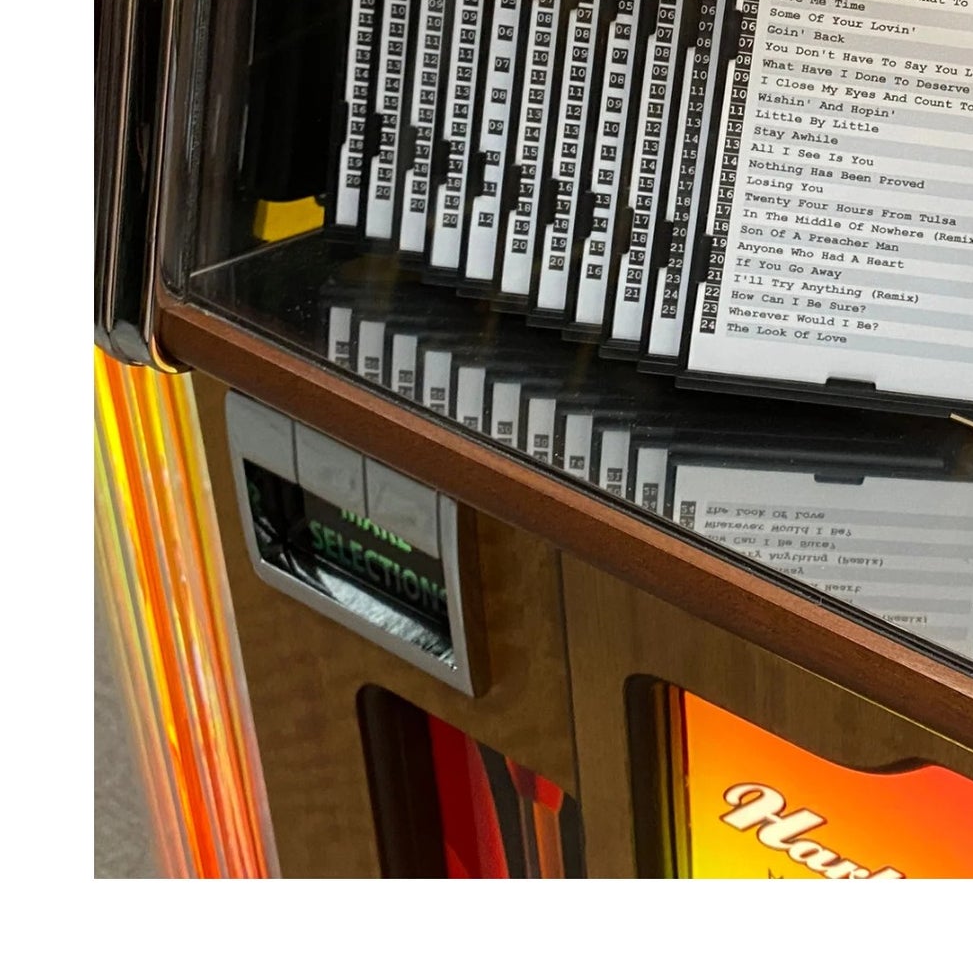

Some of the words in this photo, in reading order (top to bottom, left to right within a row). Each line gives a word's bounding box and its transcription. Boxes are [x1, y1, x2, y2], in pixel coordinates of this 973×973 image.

[767, 24, 804, 37] Goin'
[813, 31, 845, 44] Back
[762, 58, 794, 71] What
[801, 64, 833, 76] Have
[840, 69, 848, 78] I
[854, 71, 887, 83] Done
[894, 76, 910, 86] To
[916, 79, 970, 94] Deserve
[758, 92, 811, 107] Wishin'
[819, 101, 844, 112] And
[850, 105, 895, 118] Hopin'
[753, 126, 786, 140] Stay
[791, 131, 838, 145] Awhile
[748, 159, 804, 176] Nothing
[810, 167, 833, 178] Has
[840, 171, 871, 183] Been
[879, 176, 925, 189] Proved
[376, 186, 391, 198] 20
[410, 199, 425, 211] 20
[744, 192, 791, 208] Twenty
[798, 198, 829, 210] Four
[836, 203, 874, 216] Hours
[881, 209, 912, 221] From
[919, 213, 957, 226] Tulsa
[443, 214, 458, 226] 20
[478, 211, 494, 223] 12
[743, 208, 758, 219] In
[765, 211, 789, 222] The
[795, 215, 842, 229] Middle
[848, 222, 865, 231] Of
[870, 224, 924, 239] Nowhere
[740, 224, 763, 236] Son
[770, 228, 786, 239] Of
[792, 231, 802, 241] A
[808, 233, 870, 248] Preacher
[875, 241, 899, 252] Man
[549, 256, 564, 268] 20
[587, 265, 602, 277] 16
[625, 287, 640, 299] 21
[734, 274, 764, 286] I'll
[771, 278, 795, 291] Try
[800, 282, 863, 299] Anything
[871, 290, 919, 304] (Remix)
[662, 303, 676, 315] 25
[726, 322, 750, 333] The
[756, 326, 787, 337] Look
[794, 330, 810, 339] Of
[816, 332, 847, 343] Love
[310, 520, 447, 612] SELECTION
[718, 782, 906, 878] Har
